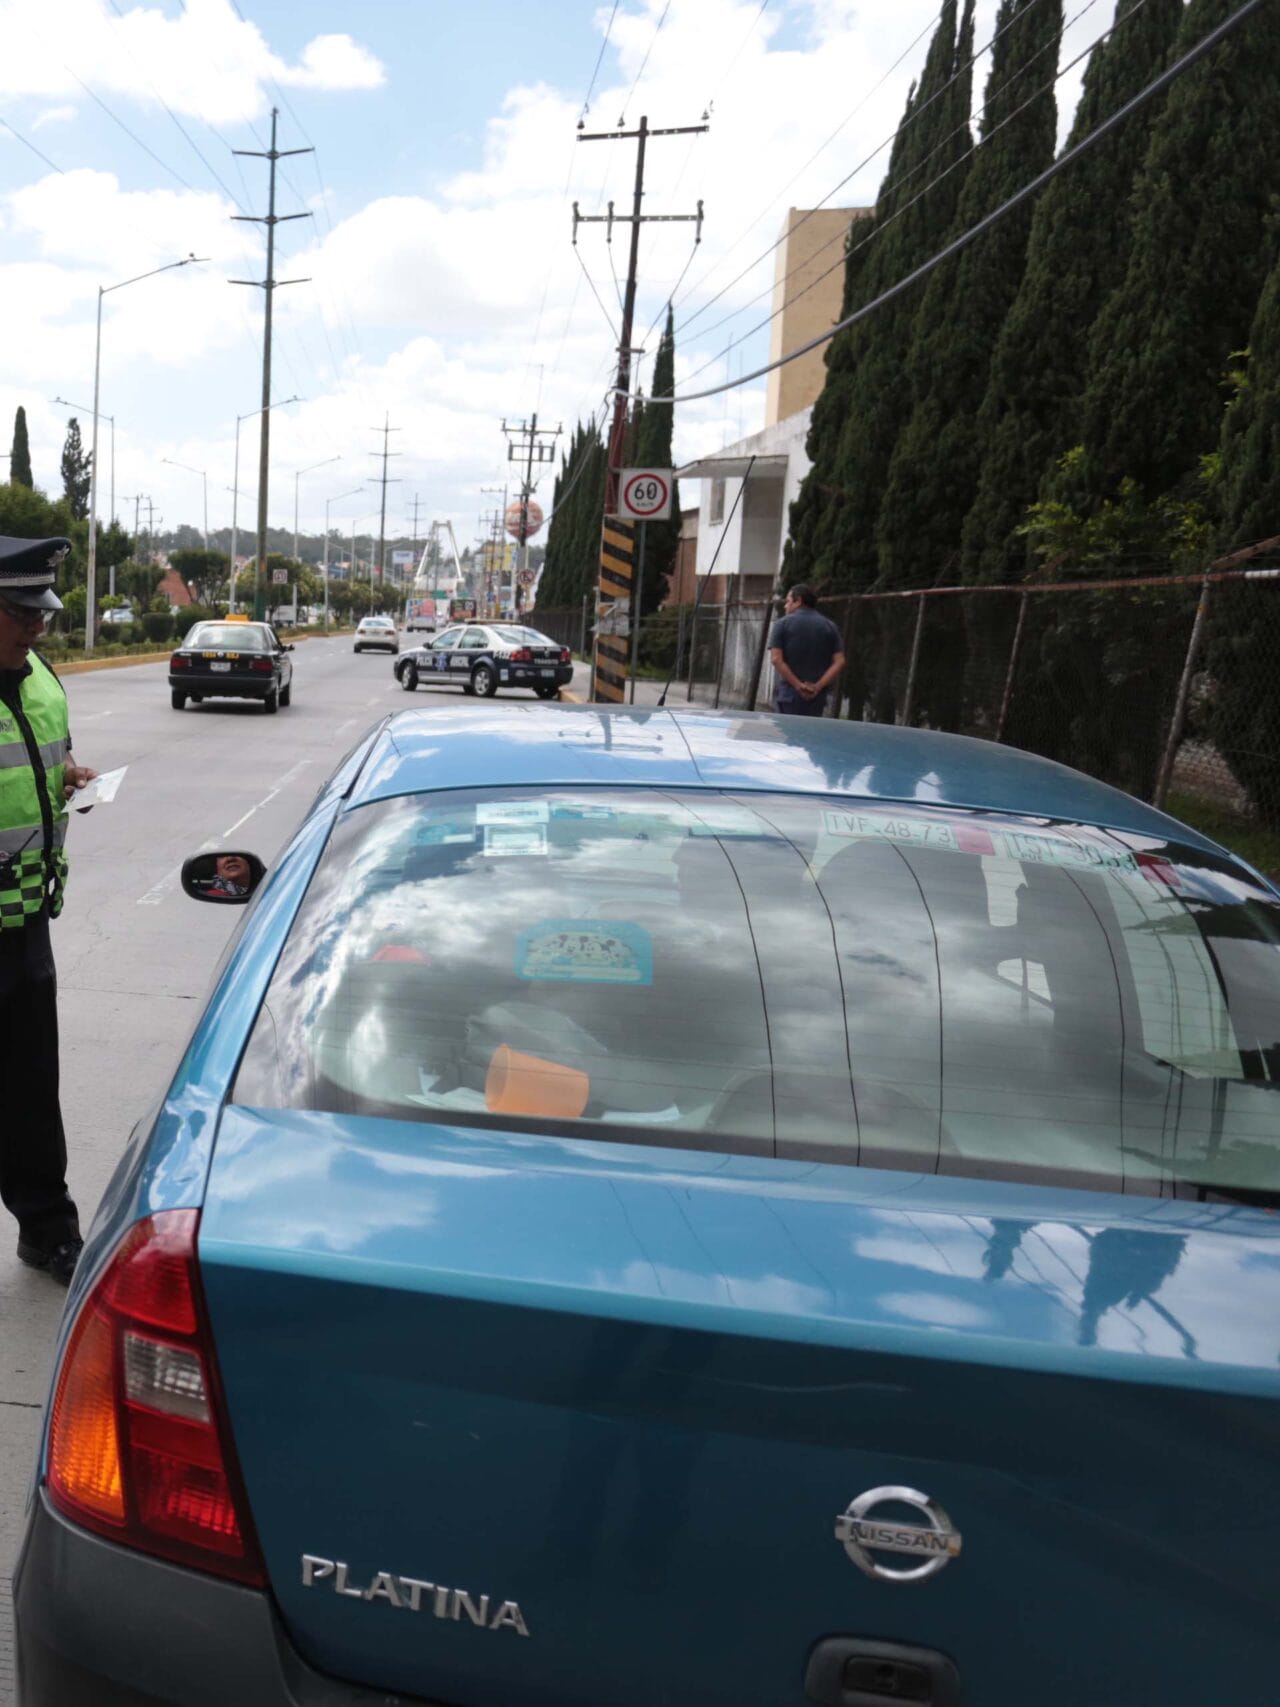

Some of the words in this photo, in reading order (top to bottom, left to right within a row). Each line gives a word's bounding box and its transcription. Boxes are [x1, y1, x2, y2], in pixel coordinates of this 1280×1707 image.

[634, 481, 658, 500] 60
[849, 1521, 949, 1551] NISSAN
[301, 1553, 530, 1637] PLATINA
